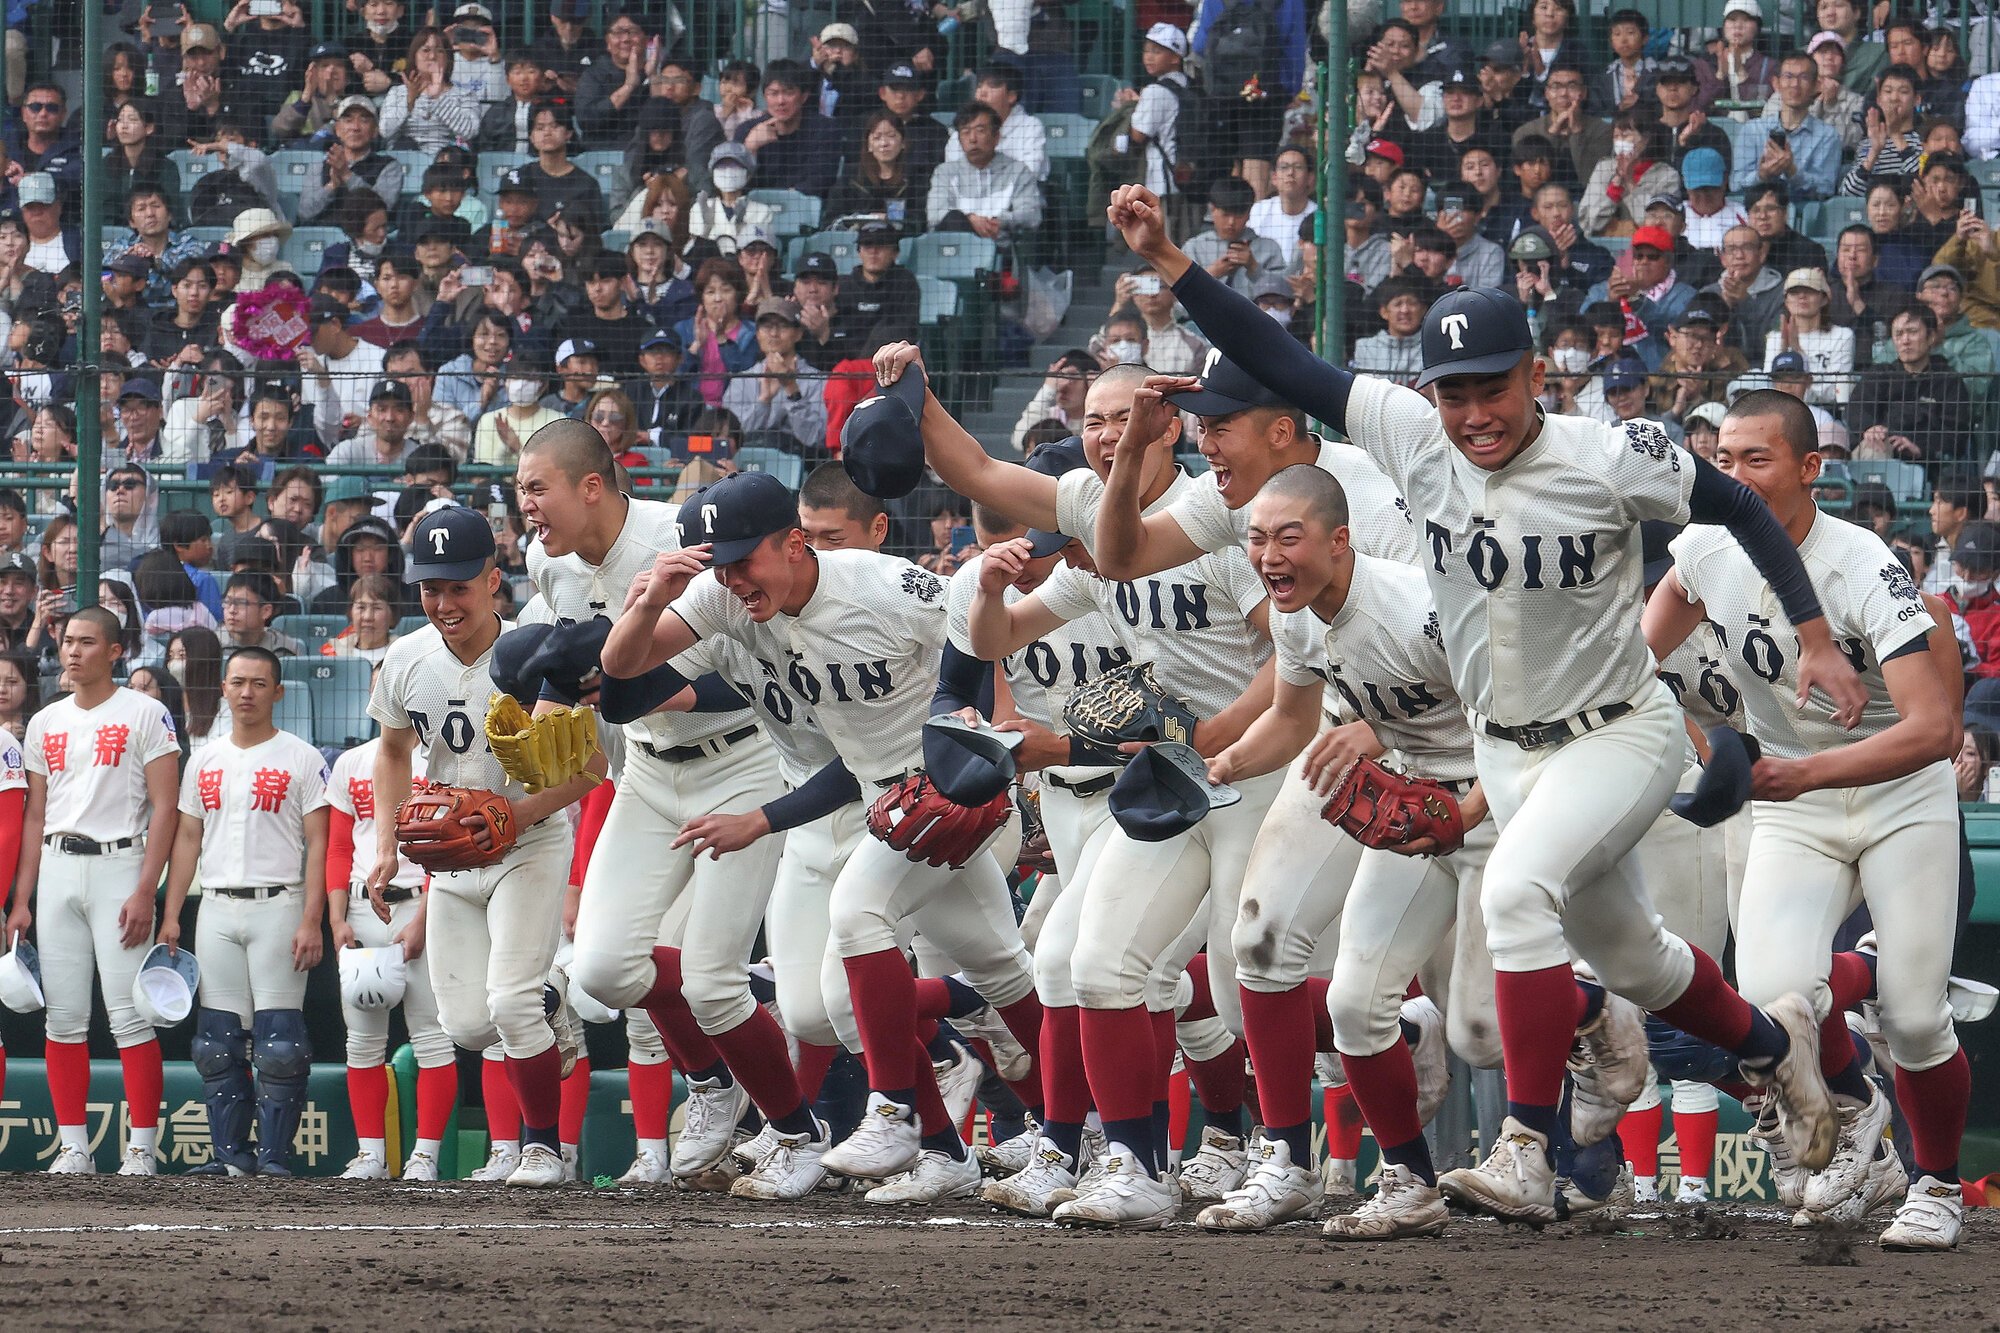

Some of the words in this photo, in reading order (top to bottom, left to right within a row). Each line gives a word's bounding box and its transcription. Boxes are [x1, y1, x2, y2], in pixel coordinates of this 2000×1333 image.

[1440, 313, 1469, 350] T
[701, 503, 718, 534] T
[428, 527, 450, 555] T
[1115, 578, 1212, 632] OIN
